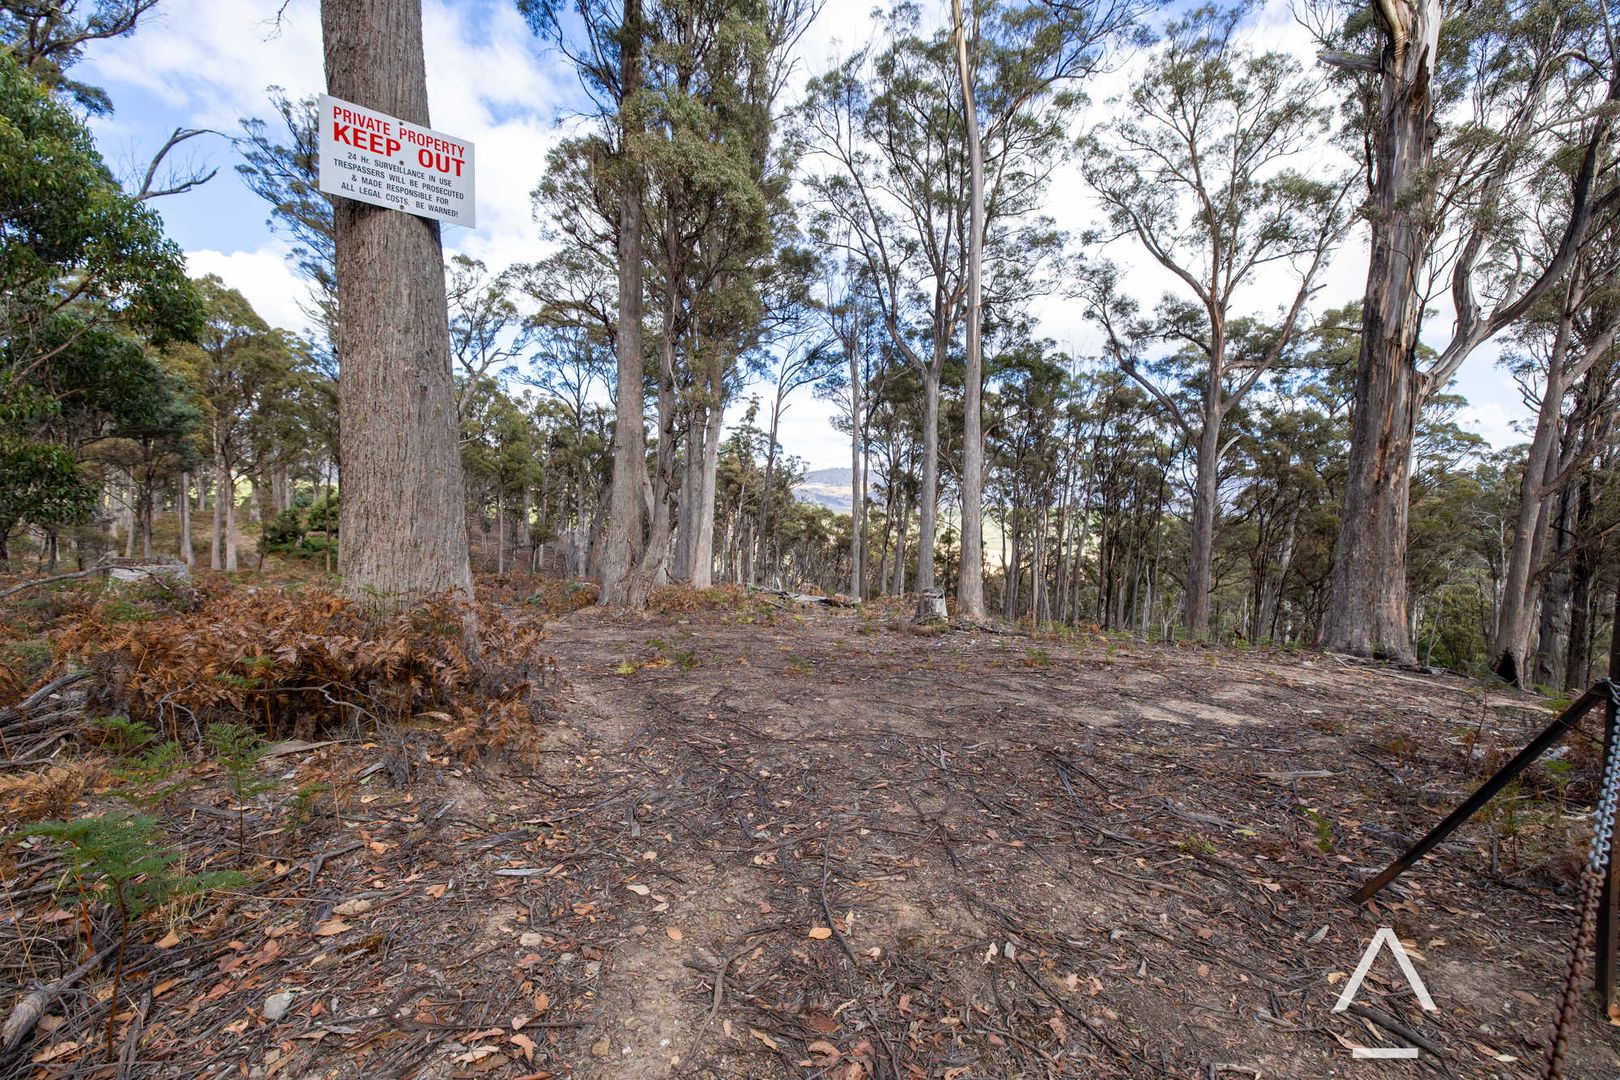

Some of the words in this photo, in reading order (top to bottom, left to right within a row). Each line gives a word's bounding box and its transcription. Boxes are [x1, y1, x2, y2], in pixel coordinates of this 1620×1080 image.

[333, 106, 391, 136] PRIVATE
[399, 127, 465, 158] PROPERTY
[333, 122, 401, 157] KEEP
[418, 148, 465, 177] OUT
[333, 158, 385, 179] TRESPASSERS
[389, 173, 406, 185] WILL
[409, 179, 419, 188] BE
[422, 182, 464, 200] PROSECUTED
[347, 152, 357, 161] 24
[374, 159, 425, 180] SURVEILLANCE
[428, 175, 436, 183] IN
[439, 177, 452, 188] USE
[341, 182, 355, 193] ALL
[359, 186, 382, 199] LEGAL
[415, 201, 425, 210] BE
[428, 204, 459, 218] WARNED!
[351, 174, 357, 182] &
[361, 176, 383, 189] MADE
[386, 183, 433, 202] RESPONSIBLE
[436, 196, 449, 206] FOR
